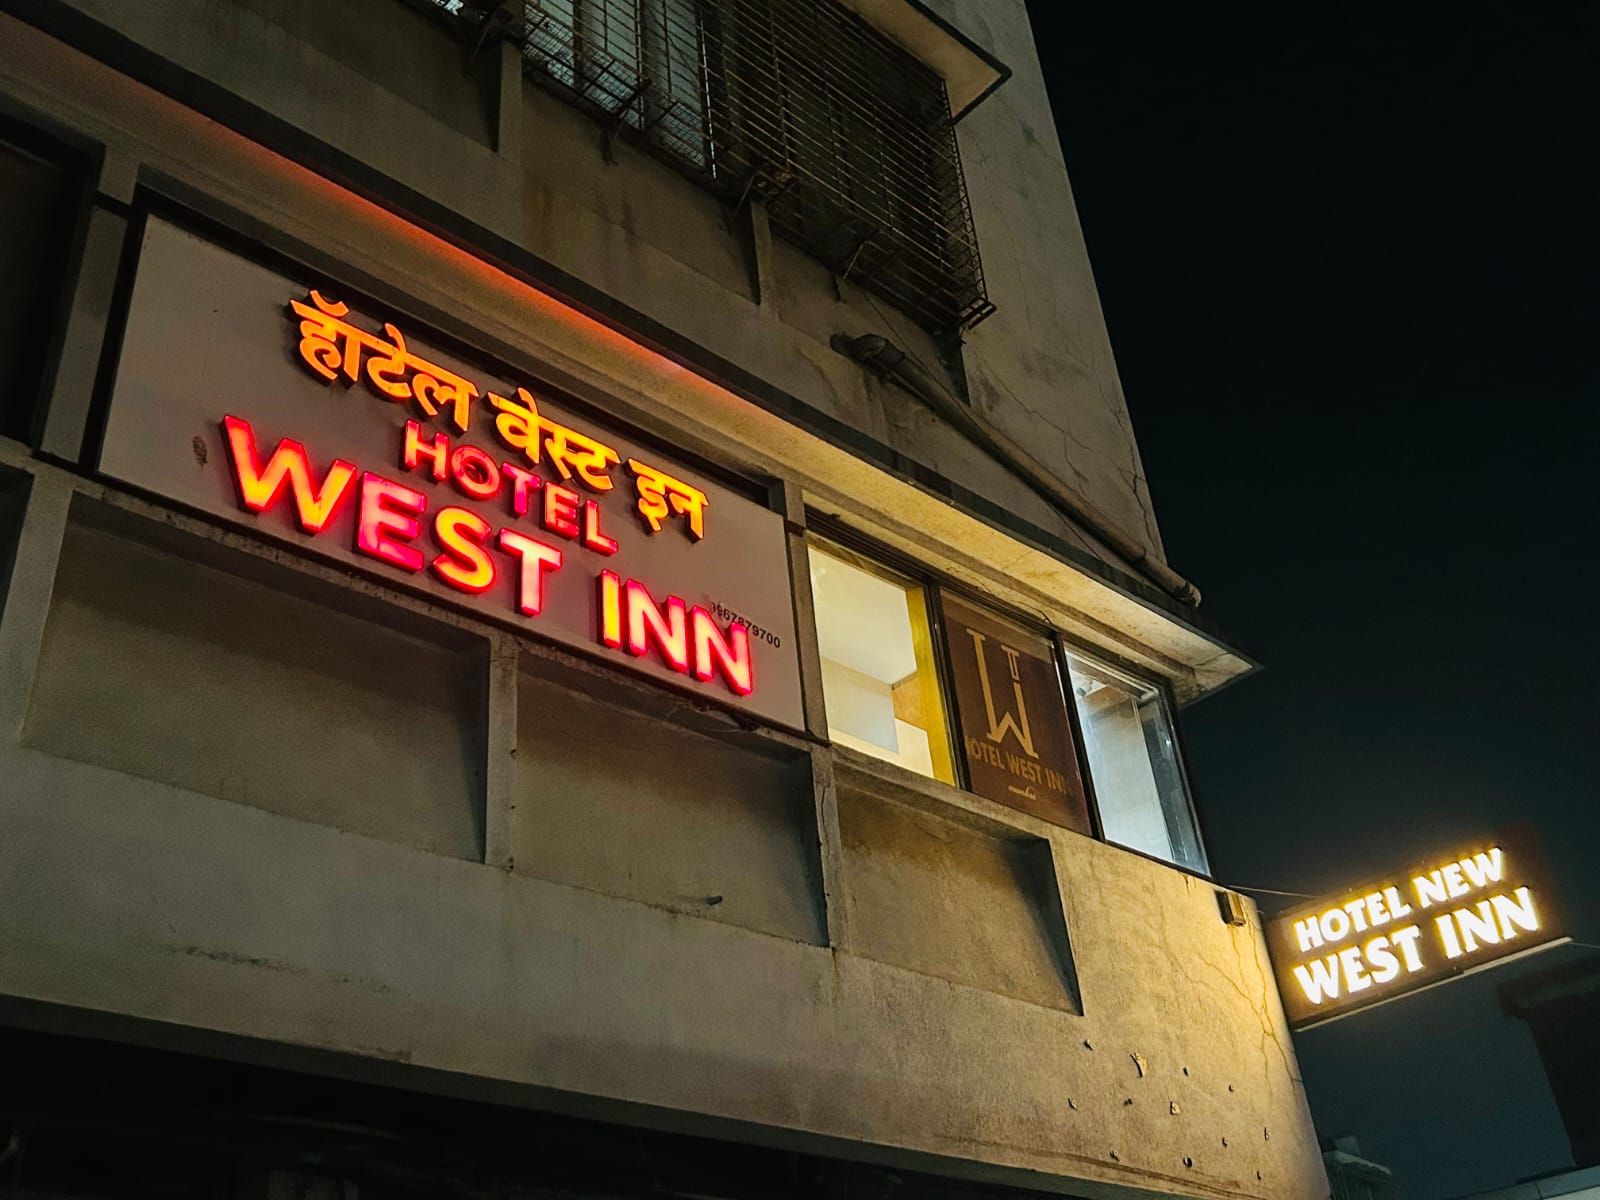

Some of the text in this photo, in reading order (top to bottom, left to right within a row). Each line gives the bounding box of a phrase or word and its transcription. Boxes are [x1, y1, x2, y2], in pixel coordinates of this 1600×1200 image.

[288, 289, 709, 540] हॉटेल वेस्ट इन
[402, 419, 619, 555] HOTEL
[221, 414, 753, 696] WEST INN
[1005, 751, 1043, 785] WEST
[1293, 886, 1540, 1005] WEST INN
[1294, 847, 1504, 953] HOTEL NEW
